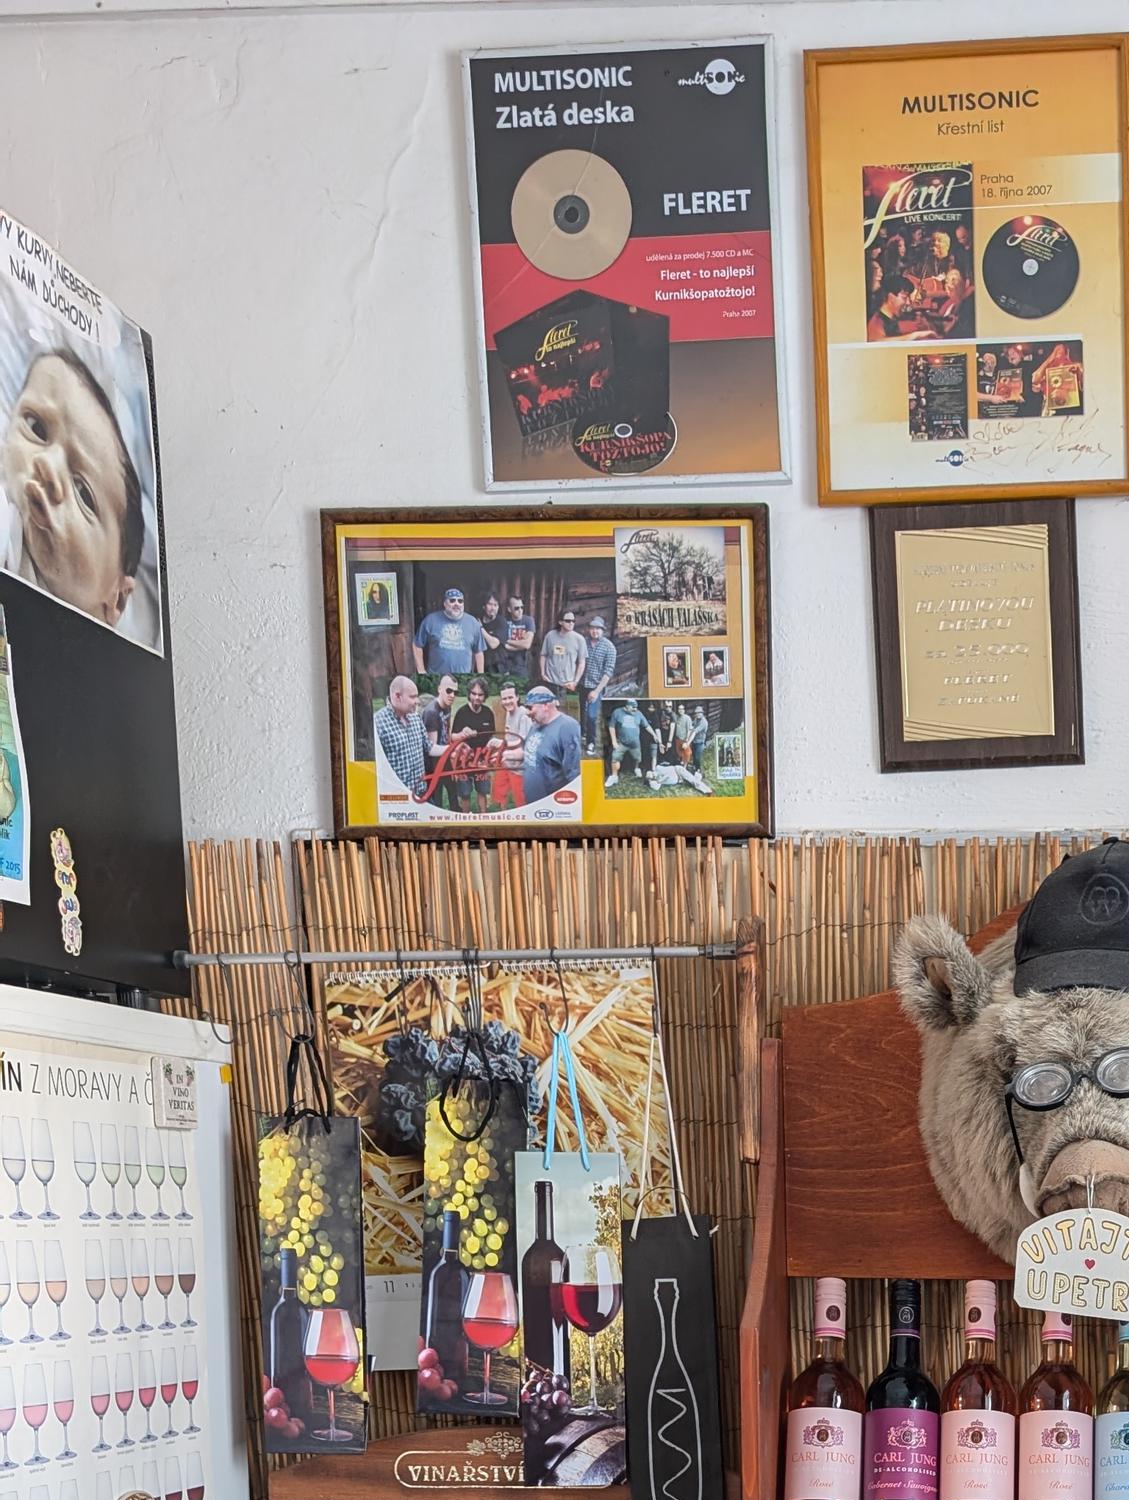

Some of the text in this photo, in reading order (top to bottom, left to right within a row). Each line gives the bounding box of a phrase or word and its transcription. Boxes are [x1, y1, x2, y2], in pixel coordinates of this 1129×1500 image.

[495, 66, 632, 93] MULTISONIC
[902, 89, 1039, 114] MULTISONIC
[496, 101, 635, 129] Zlatá deska
[937, 120, 1005, 135] Křestní list
[981, 175, 1014, 185] Praha
[981, 188, 996, 198] 18.
[1027, 185, 1052, 195] 2007
[664, 189, 751, 215] FLERET
[923, 213, 962, 221] KONCERT
[683, 251, 705, 261] prodej
[660, 266, 754, 280] Fleret to najlepší
[10, 255, 38, 295] NÁM
[43, 279, 92, 336] DŮCHODY
[655, 287, 755, 301] Kurnikšopatožtojo!
[723, 309, 756, 318] Praha 2007
[0, 1051, 139, 1104] ÍN Z MORAVY A
[176, 1074, 184, 1083] IN
[172, 1088, 189, 1097] VINO
[168, 1099, 195, 1111] VERITAS
[792, 1452, 855, 1465] CARL JUNG
[874, 1453, 936, 1466] CARL JUNG
[1029, 1454, 1090, 1467] CARL JUNG
[1100, 1456, 1127, 1467] CARL
[407, 1457, 525, 1484] VINAŘSTVÍ
[874, 1467, 936, 1476] DE-ALCOHOLISED
